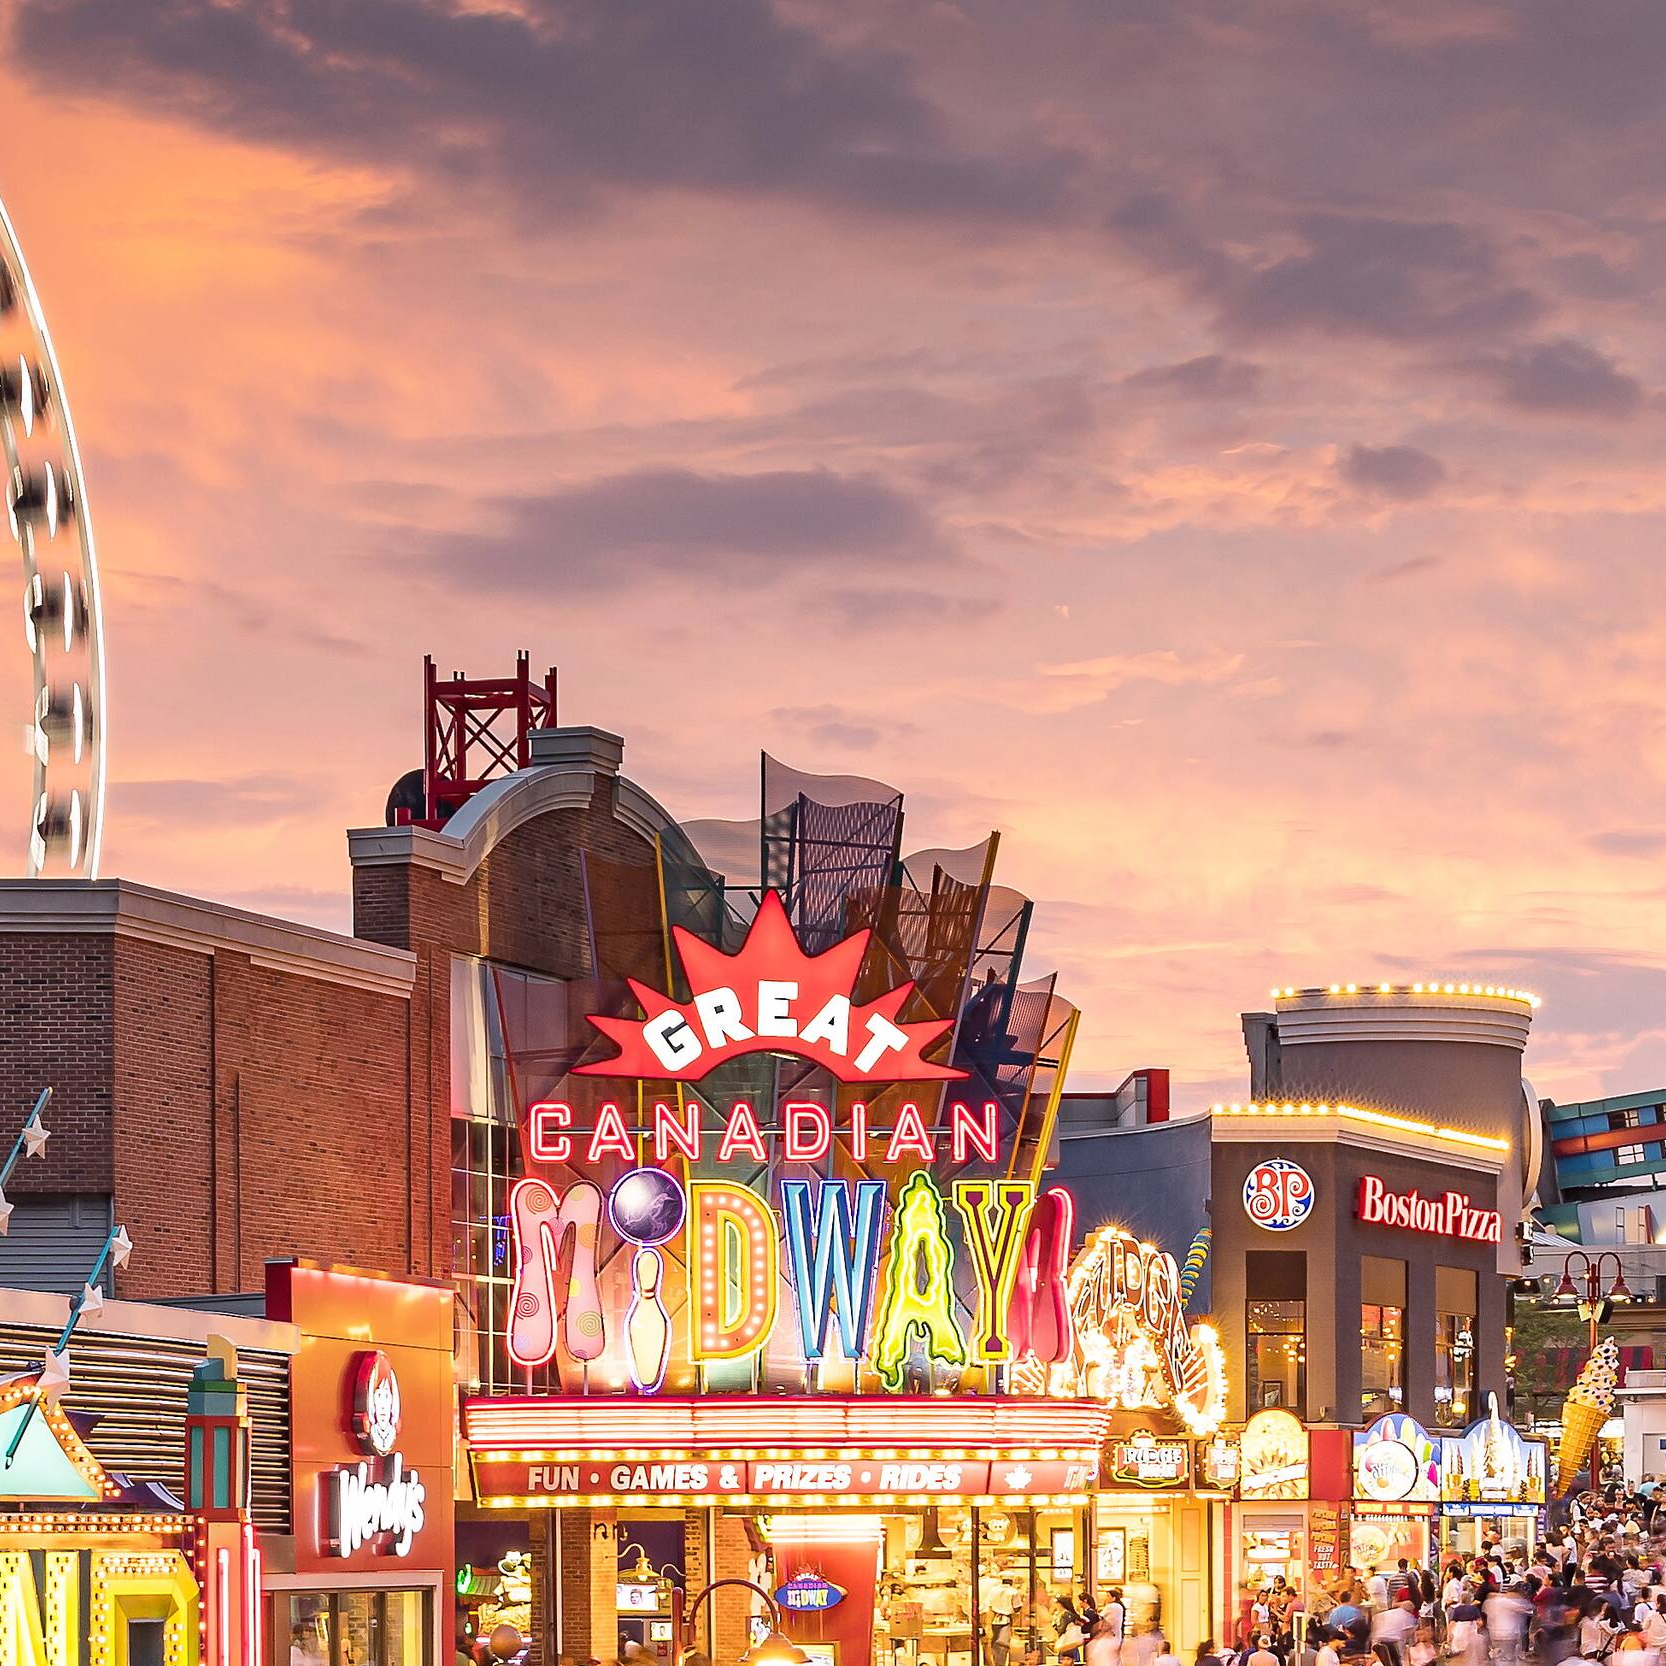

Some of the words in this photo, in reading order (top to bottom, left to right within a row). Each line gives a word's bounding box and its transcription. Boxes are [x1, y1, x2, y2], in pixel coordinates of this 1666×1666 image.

[642, 980, 909, 1073] GREAT
[530, 1100, 999, 1163] CANADIAN
[339, 1452, 427, 1559] Wendy's
[528, 1466, 580, 1491] FUN
[610, 1464, 708, 1491] GAMES
[719, 1464, 739, 1491] &
[754, 1463, 852, 1492] PRIZES
[879, 1464, 962, 1491] RIDES
